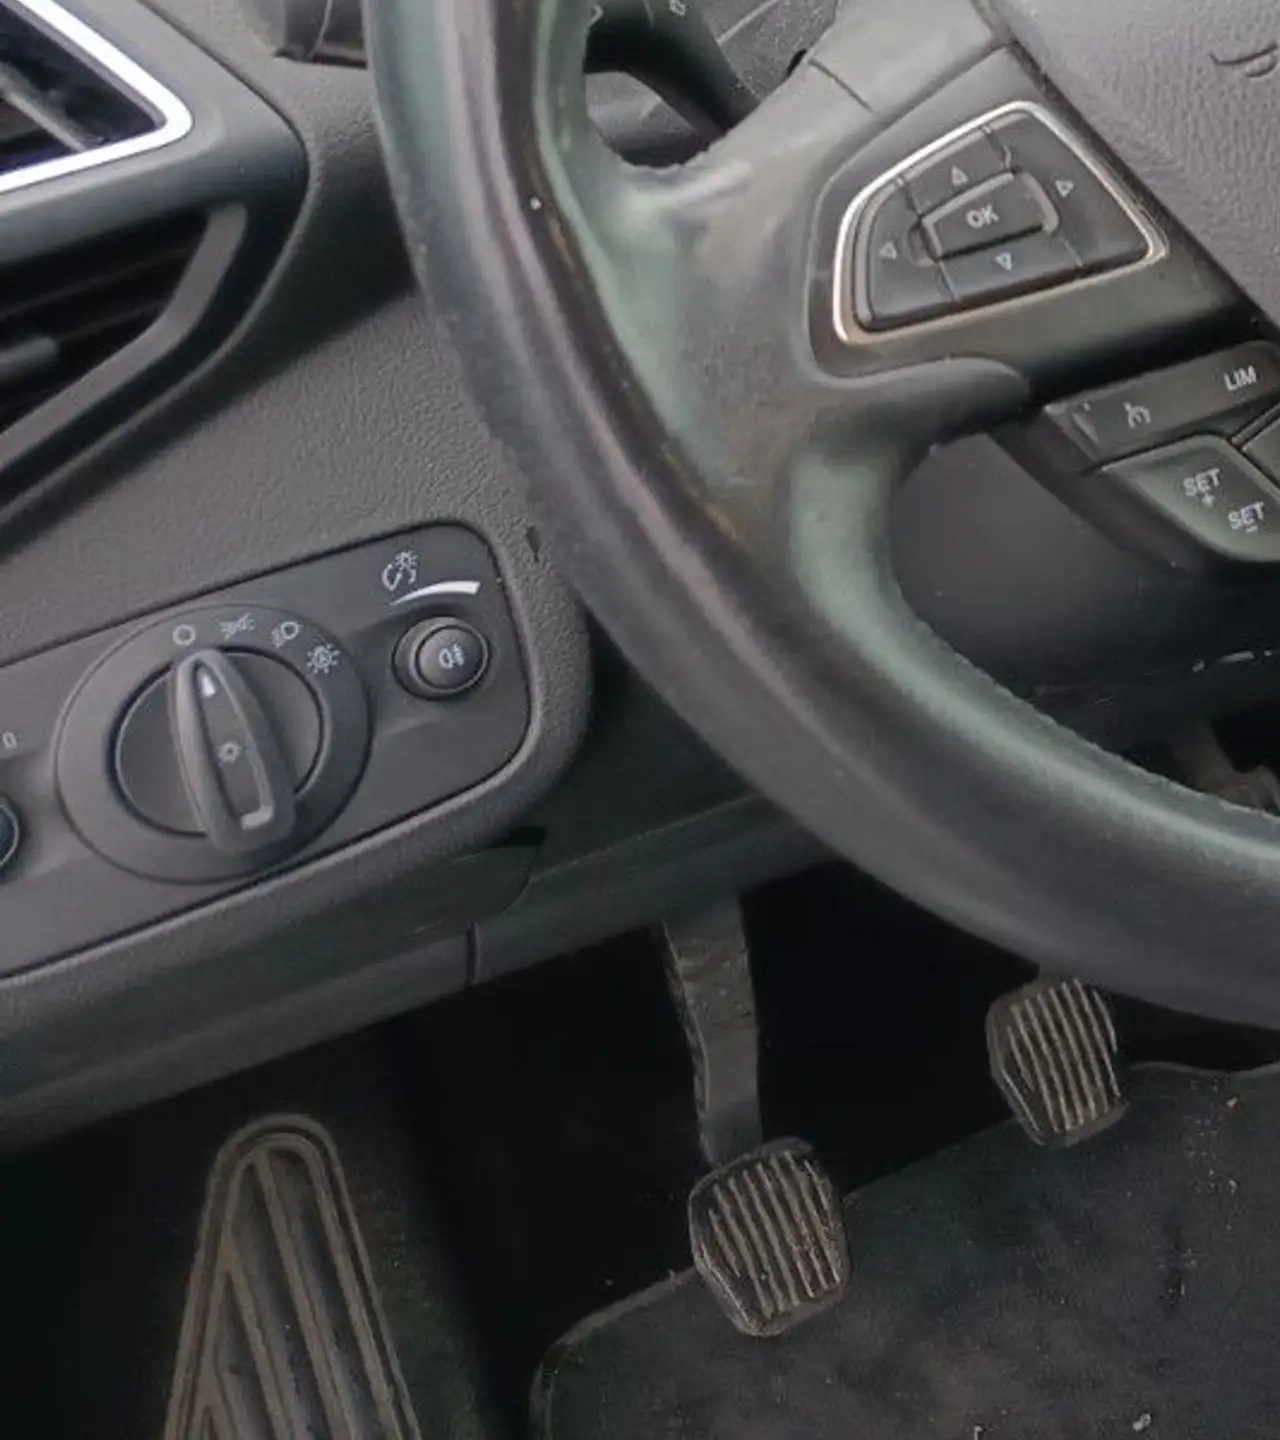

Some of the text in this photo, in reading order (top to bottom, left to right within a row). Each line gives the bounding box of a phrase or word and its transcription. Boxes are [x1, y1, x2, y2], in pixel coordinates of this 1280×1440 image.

[964, 204, 1000, 229] OK
[1222, 364, 1259, 392] LIM
[1183, 467, 1222, 497] SET
[1227, 500, 1266, 531] SET
